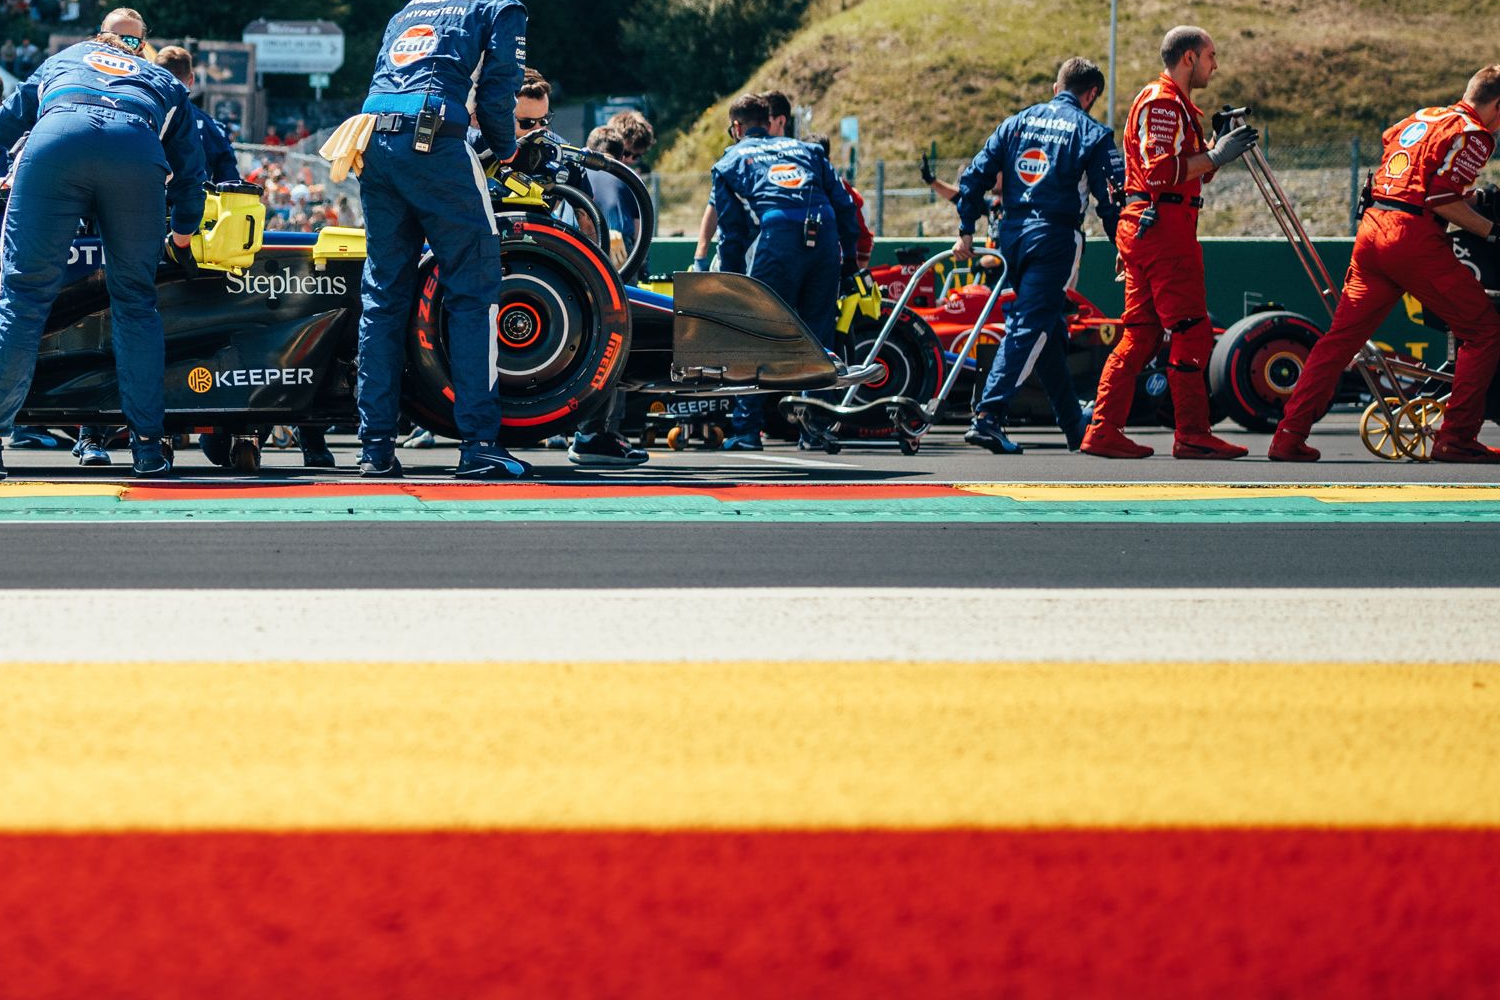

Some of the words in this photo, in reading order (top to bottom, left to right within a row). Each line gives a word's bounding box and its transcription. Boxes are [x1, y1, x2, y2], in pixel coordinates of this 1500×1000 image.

[404, 7, 467, 19] MYPROTEIN
[393, 38, 436, 53] Gulf
[1017, 160, 1048, 173] Gulf
[226, 266, 347, 300] Stephens
[591, 331, 623, 391] PIRELLI
[216, 368, 314, 388] KEEPER
[666, 399, 730, 414] KEEPER
